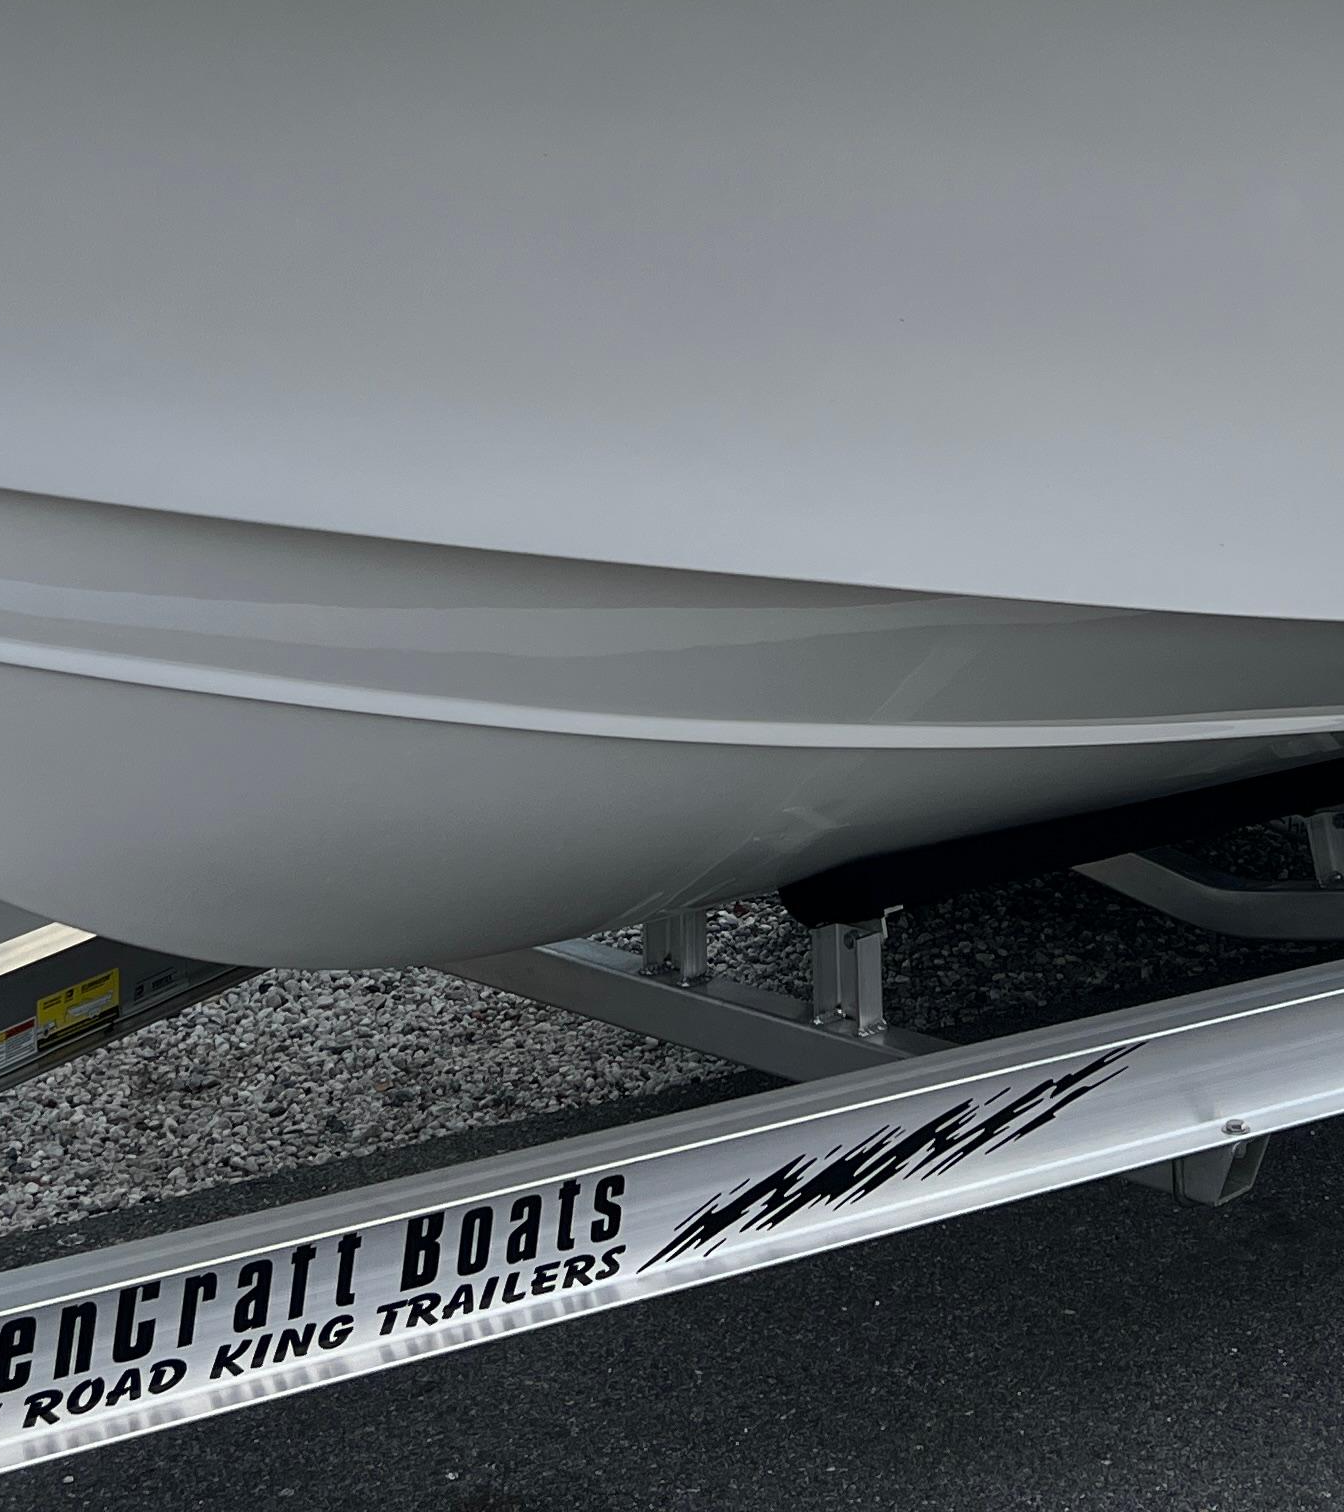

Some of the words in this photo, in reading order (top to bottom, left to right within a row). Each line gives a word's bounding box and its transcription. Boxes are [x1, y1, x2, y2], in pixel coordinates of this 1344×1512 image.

[399, 1174, 626, 1293] Boats
[22, 1359, 187, 1429] ROAD
[210, 1314, 357, 1380] KING
[377, 1245, 626, 1336] TRAILERS
